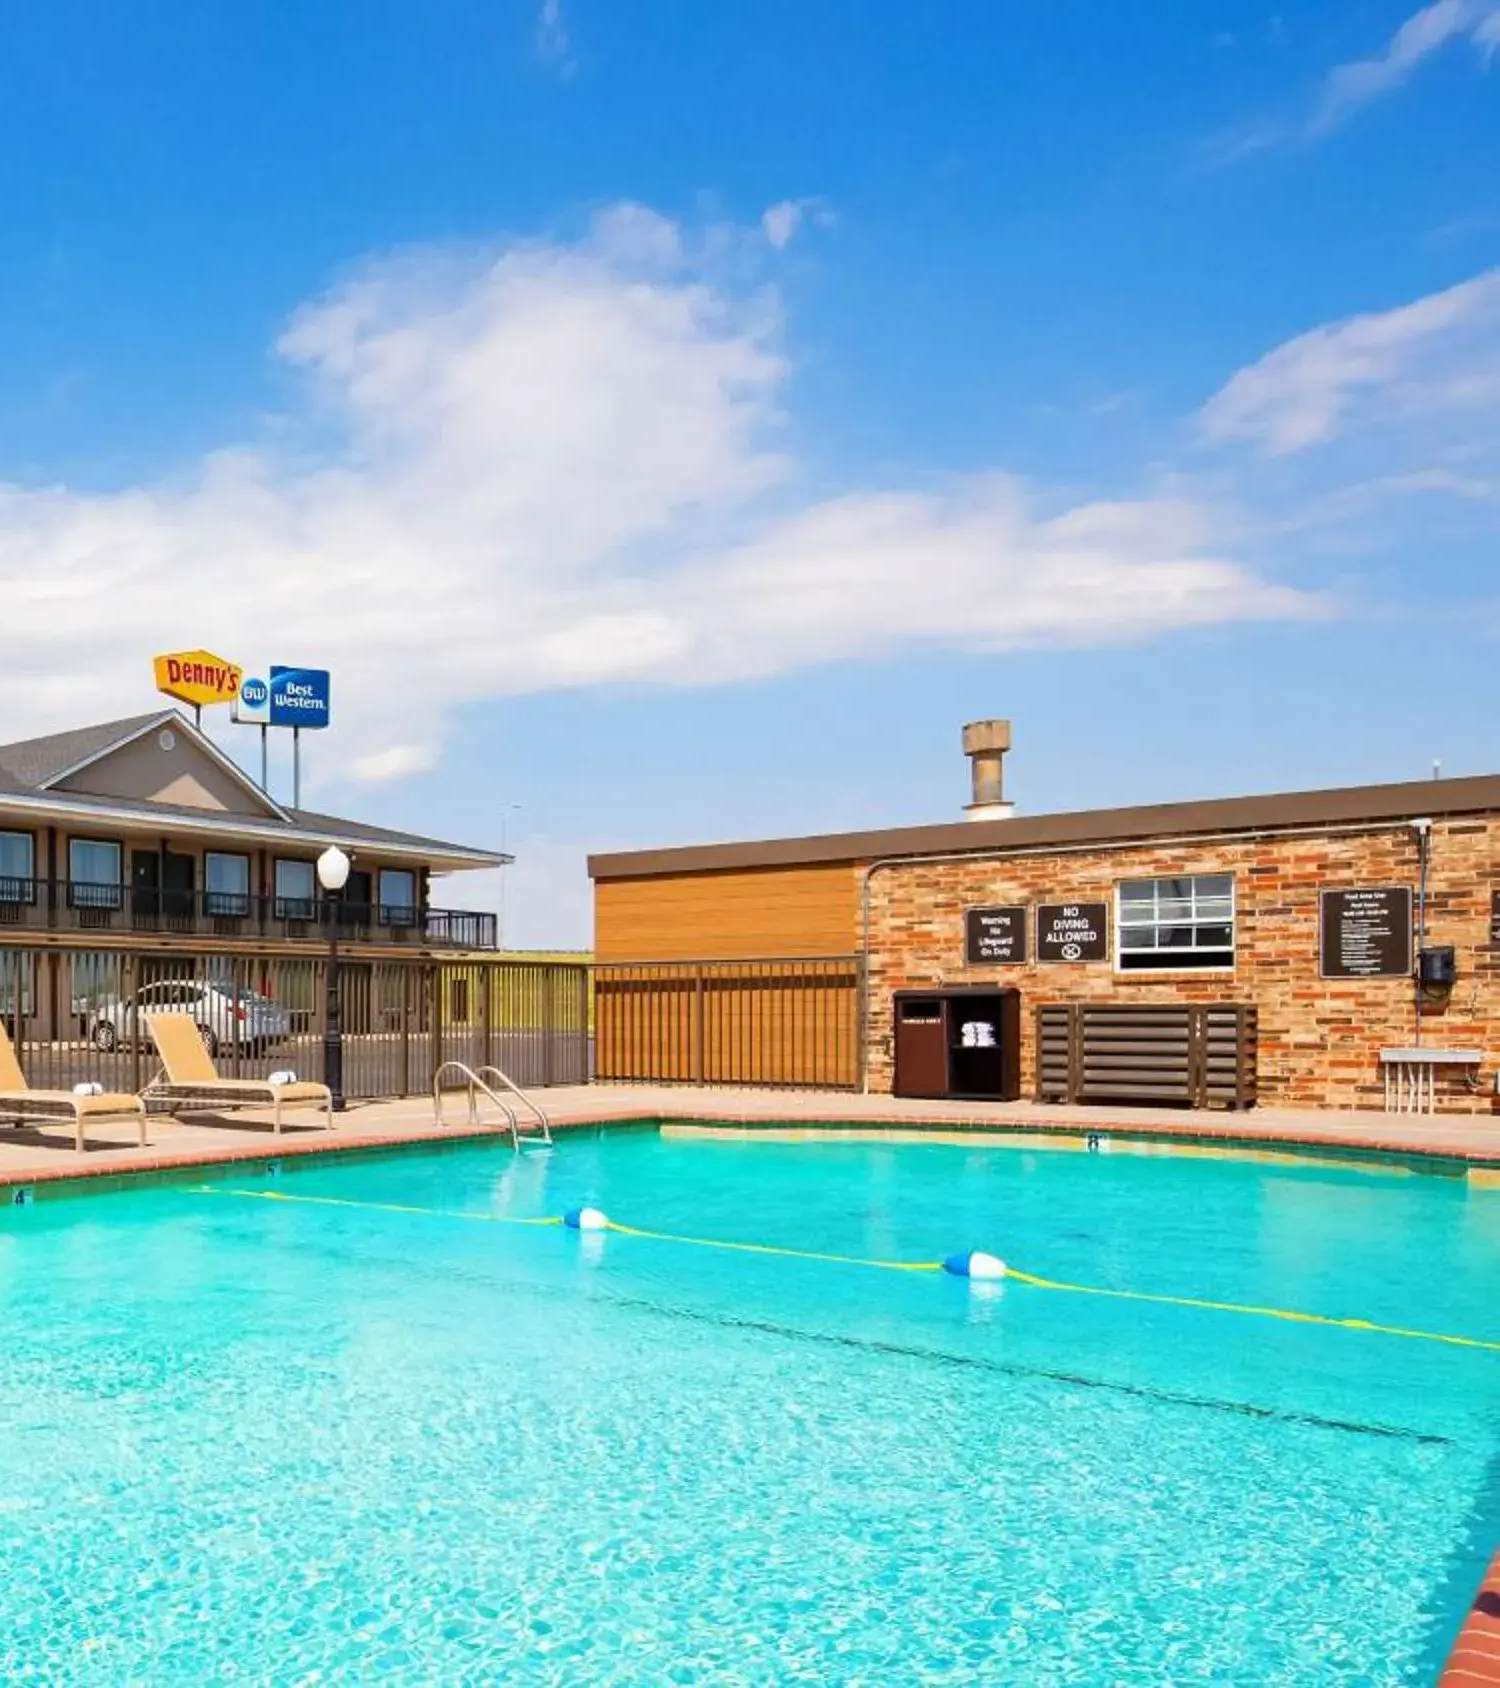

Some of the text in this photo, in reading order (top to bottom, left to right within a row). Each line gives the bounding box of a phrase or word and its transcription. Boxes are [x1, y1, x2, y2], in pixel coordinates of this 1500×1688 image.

[167, 659, 238, 693] Denny's
[243, 687, 265, 700] BW
[286, 682, 313, 696] Best
[1063, 907, 1079, 917] NO
[1053, 918, 1089, 931] DIVING
[1045, 931, 1097, 943] ALLOWED
